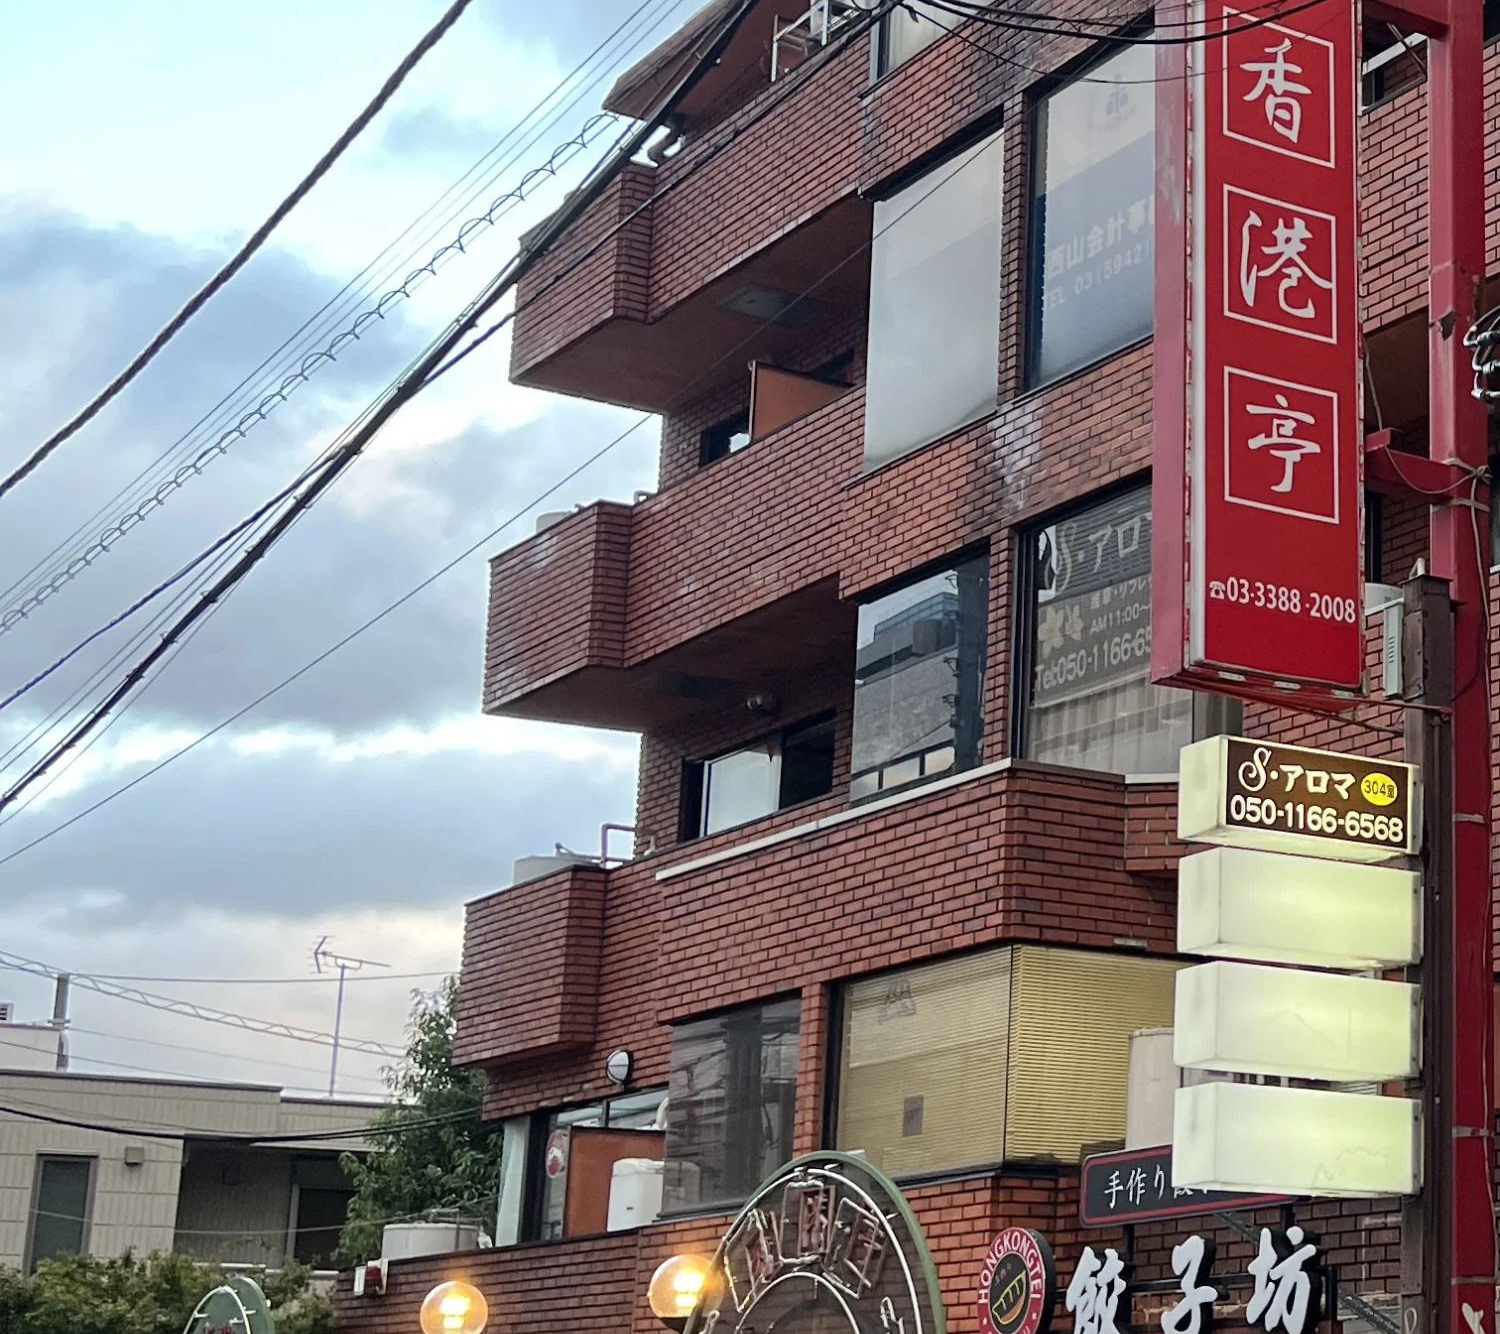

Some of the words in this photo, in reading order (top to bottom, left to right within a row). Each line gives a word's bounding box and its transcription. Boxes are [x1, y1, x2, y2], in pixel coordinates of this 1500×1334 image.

[1239, 37, 1333, 493] 香港亭
[1230, 794, 1404, 843] 050-1166-6568
[978, 1231, 1041, 1303] HONGKONGTEI
